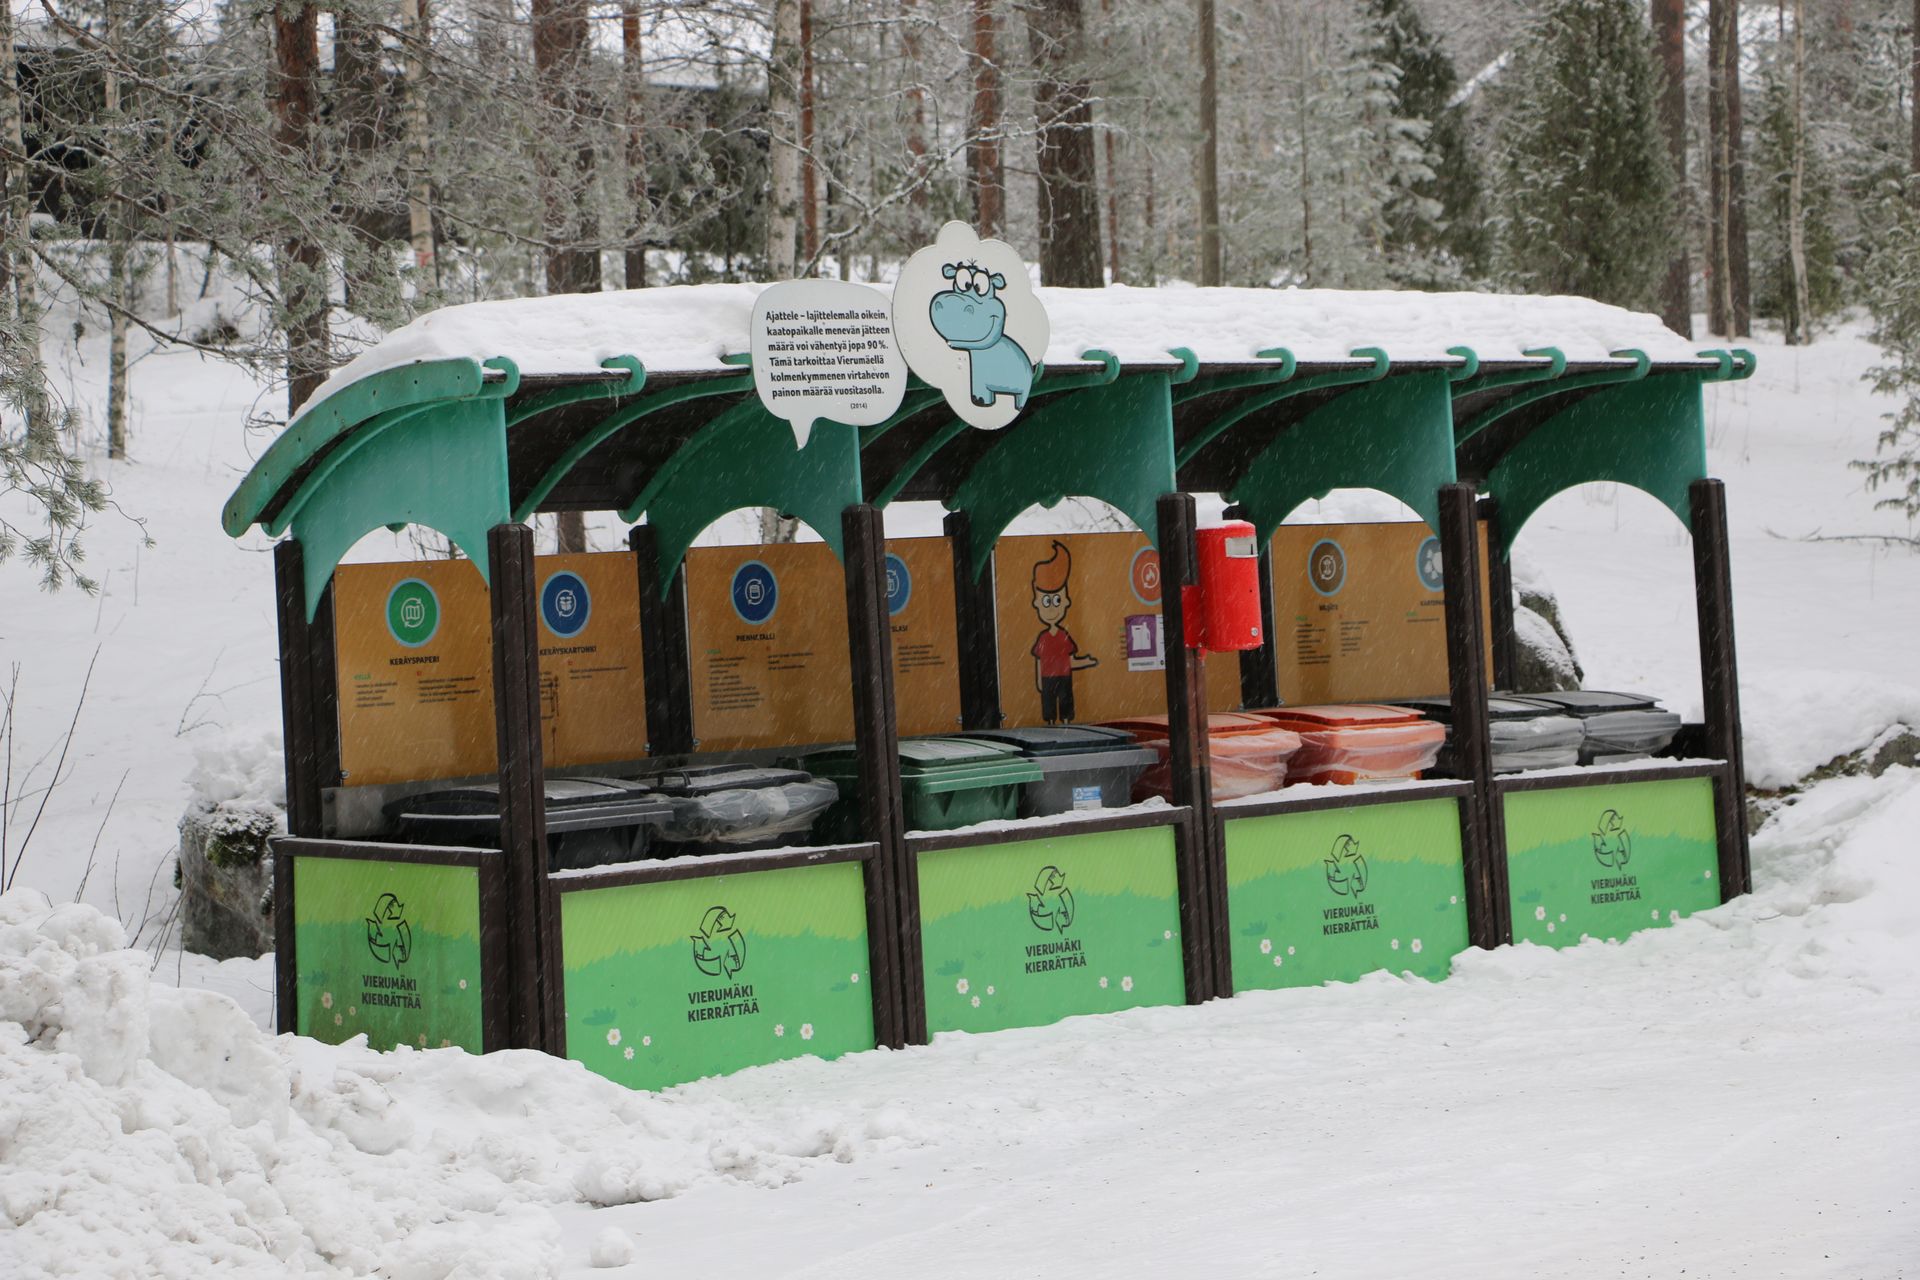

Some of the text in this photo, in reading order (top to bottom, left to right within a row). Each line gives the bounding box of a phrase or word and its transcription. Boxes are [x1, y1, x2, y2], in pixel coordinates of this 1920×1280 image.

[766, 310, 799, 323] Ajattele
[806, 310, 860, 323] lajittelemalla
[861, 310, 888, 321] oikein,
[766, 325, 890, 338] kaatopaikalle menevän jätteen
[768, 341, 795, 351] määrä
[796, 340, 809, 350] voi
[810, 340, 847, 352] vähentyä
[848, 341, 866, 352] jopa
[769, 354, 885, 367] Tämä tarkoittaa Vierumäellä
[770, 370, 890, 383] kolmenkymmenen virtahevon
[772, 385, 885, 399] painon määrää vuositasolla.
[850, 402, 868, 410] (2014)
[389, 655, 440, 666] KERÄYSPAPERI
[1590, 874, 1637, 890] VIERUMÄKI
[1590, 887, 1641, 905] KIERRÄTTÄÄ
[1322, 902, 1375, 920] VIERUMÄKI
[1322, 916, 1379, 936] KIERRÄTTÄÄ
[1025, 938, 1081, 958] VIERUMÄKI
[1025, 952, 1087, 974] KIERRÄTTÄÄ
[362, 974, 417, 991] VIERUMÄKI
[361, 991, 422, 1009] KIERRÄTTÄÄ
[688, 983, 753, 1005] VIERUMÄKI
[687, 998, 760, 1023] KIERRÄTTÄÄ
